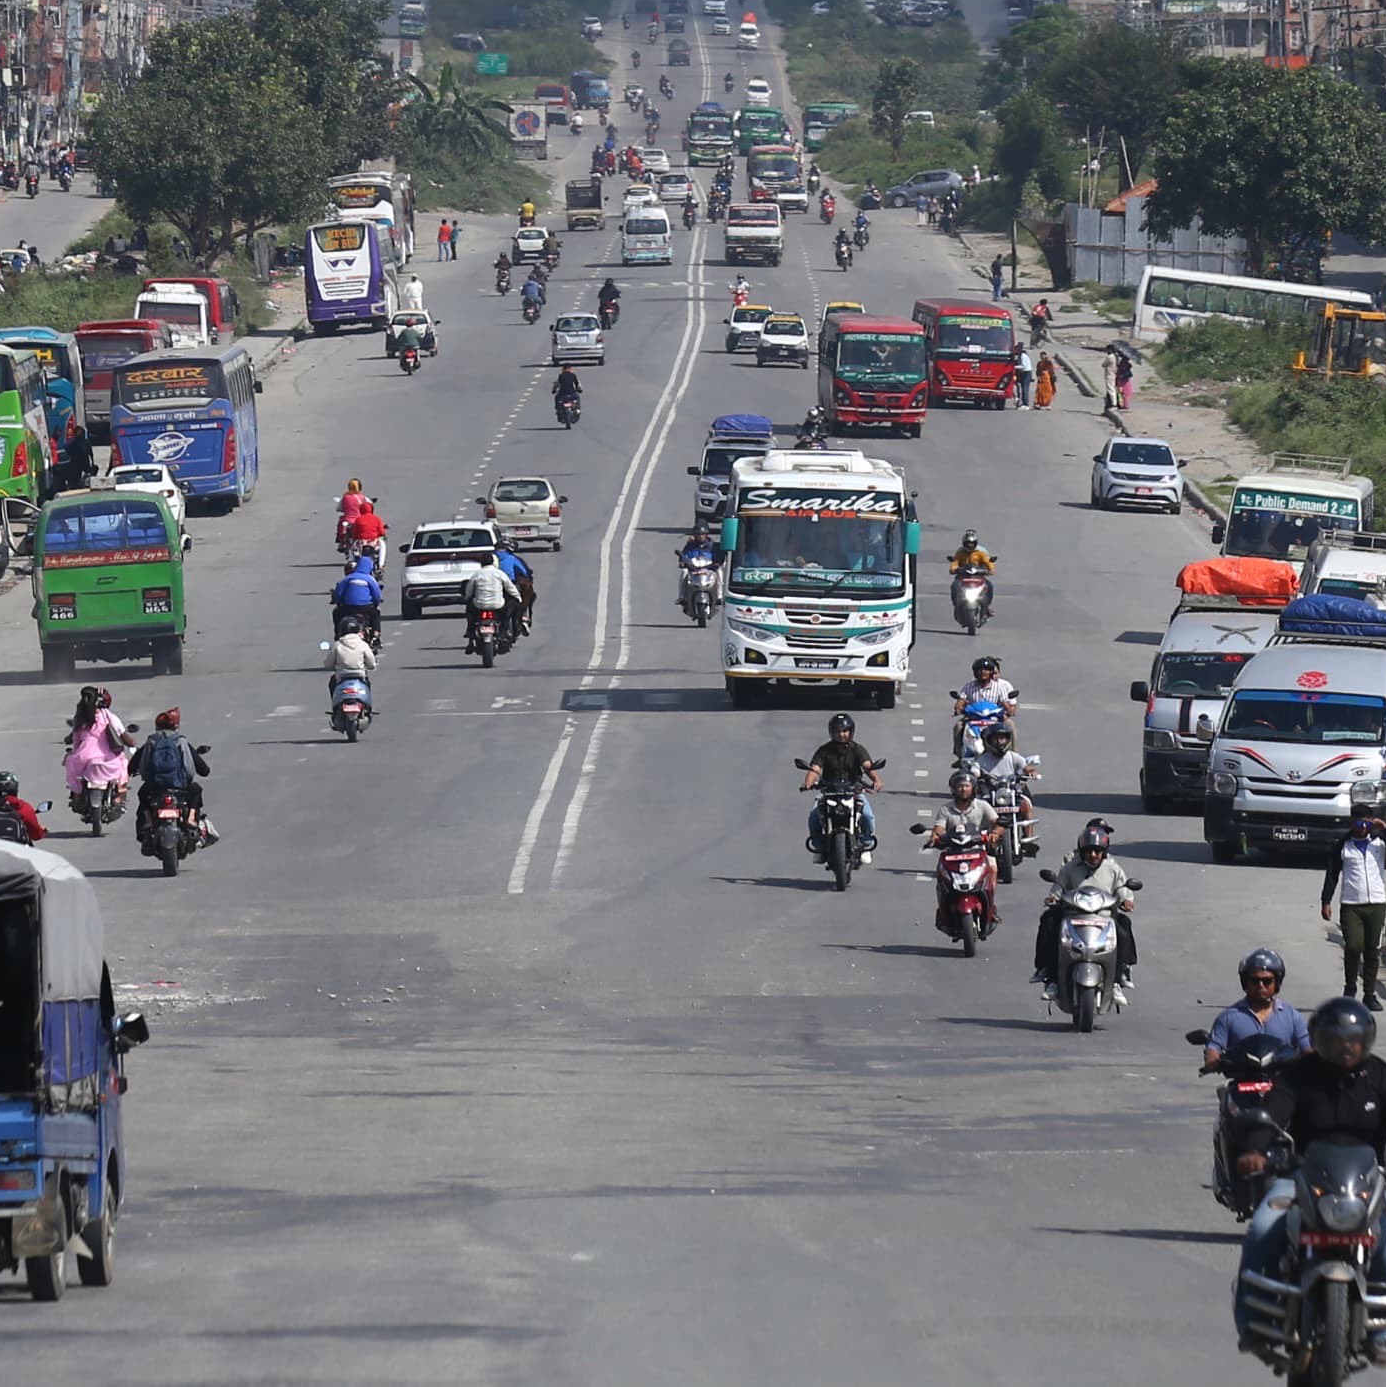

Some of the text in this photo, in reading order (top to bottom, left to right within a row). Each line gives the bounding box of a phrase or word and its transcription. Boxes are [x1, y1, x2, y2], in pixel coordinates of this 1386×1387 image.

[125, 367, 206, 382] दरबार
[740, 489, 899, 513] Smarika
[1254, 495, 1339, 513] Public Demand 2
